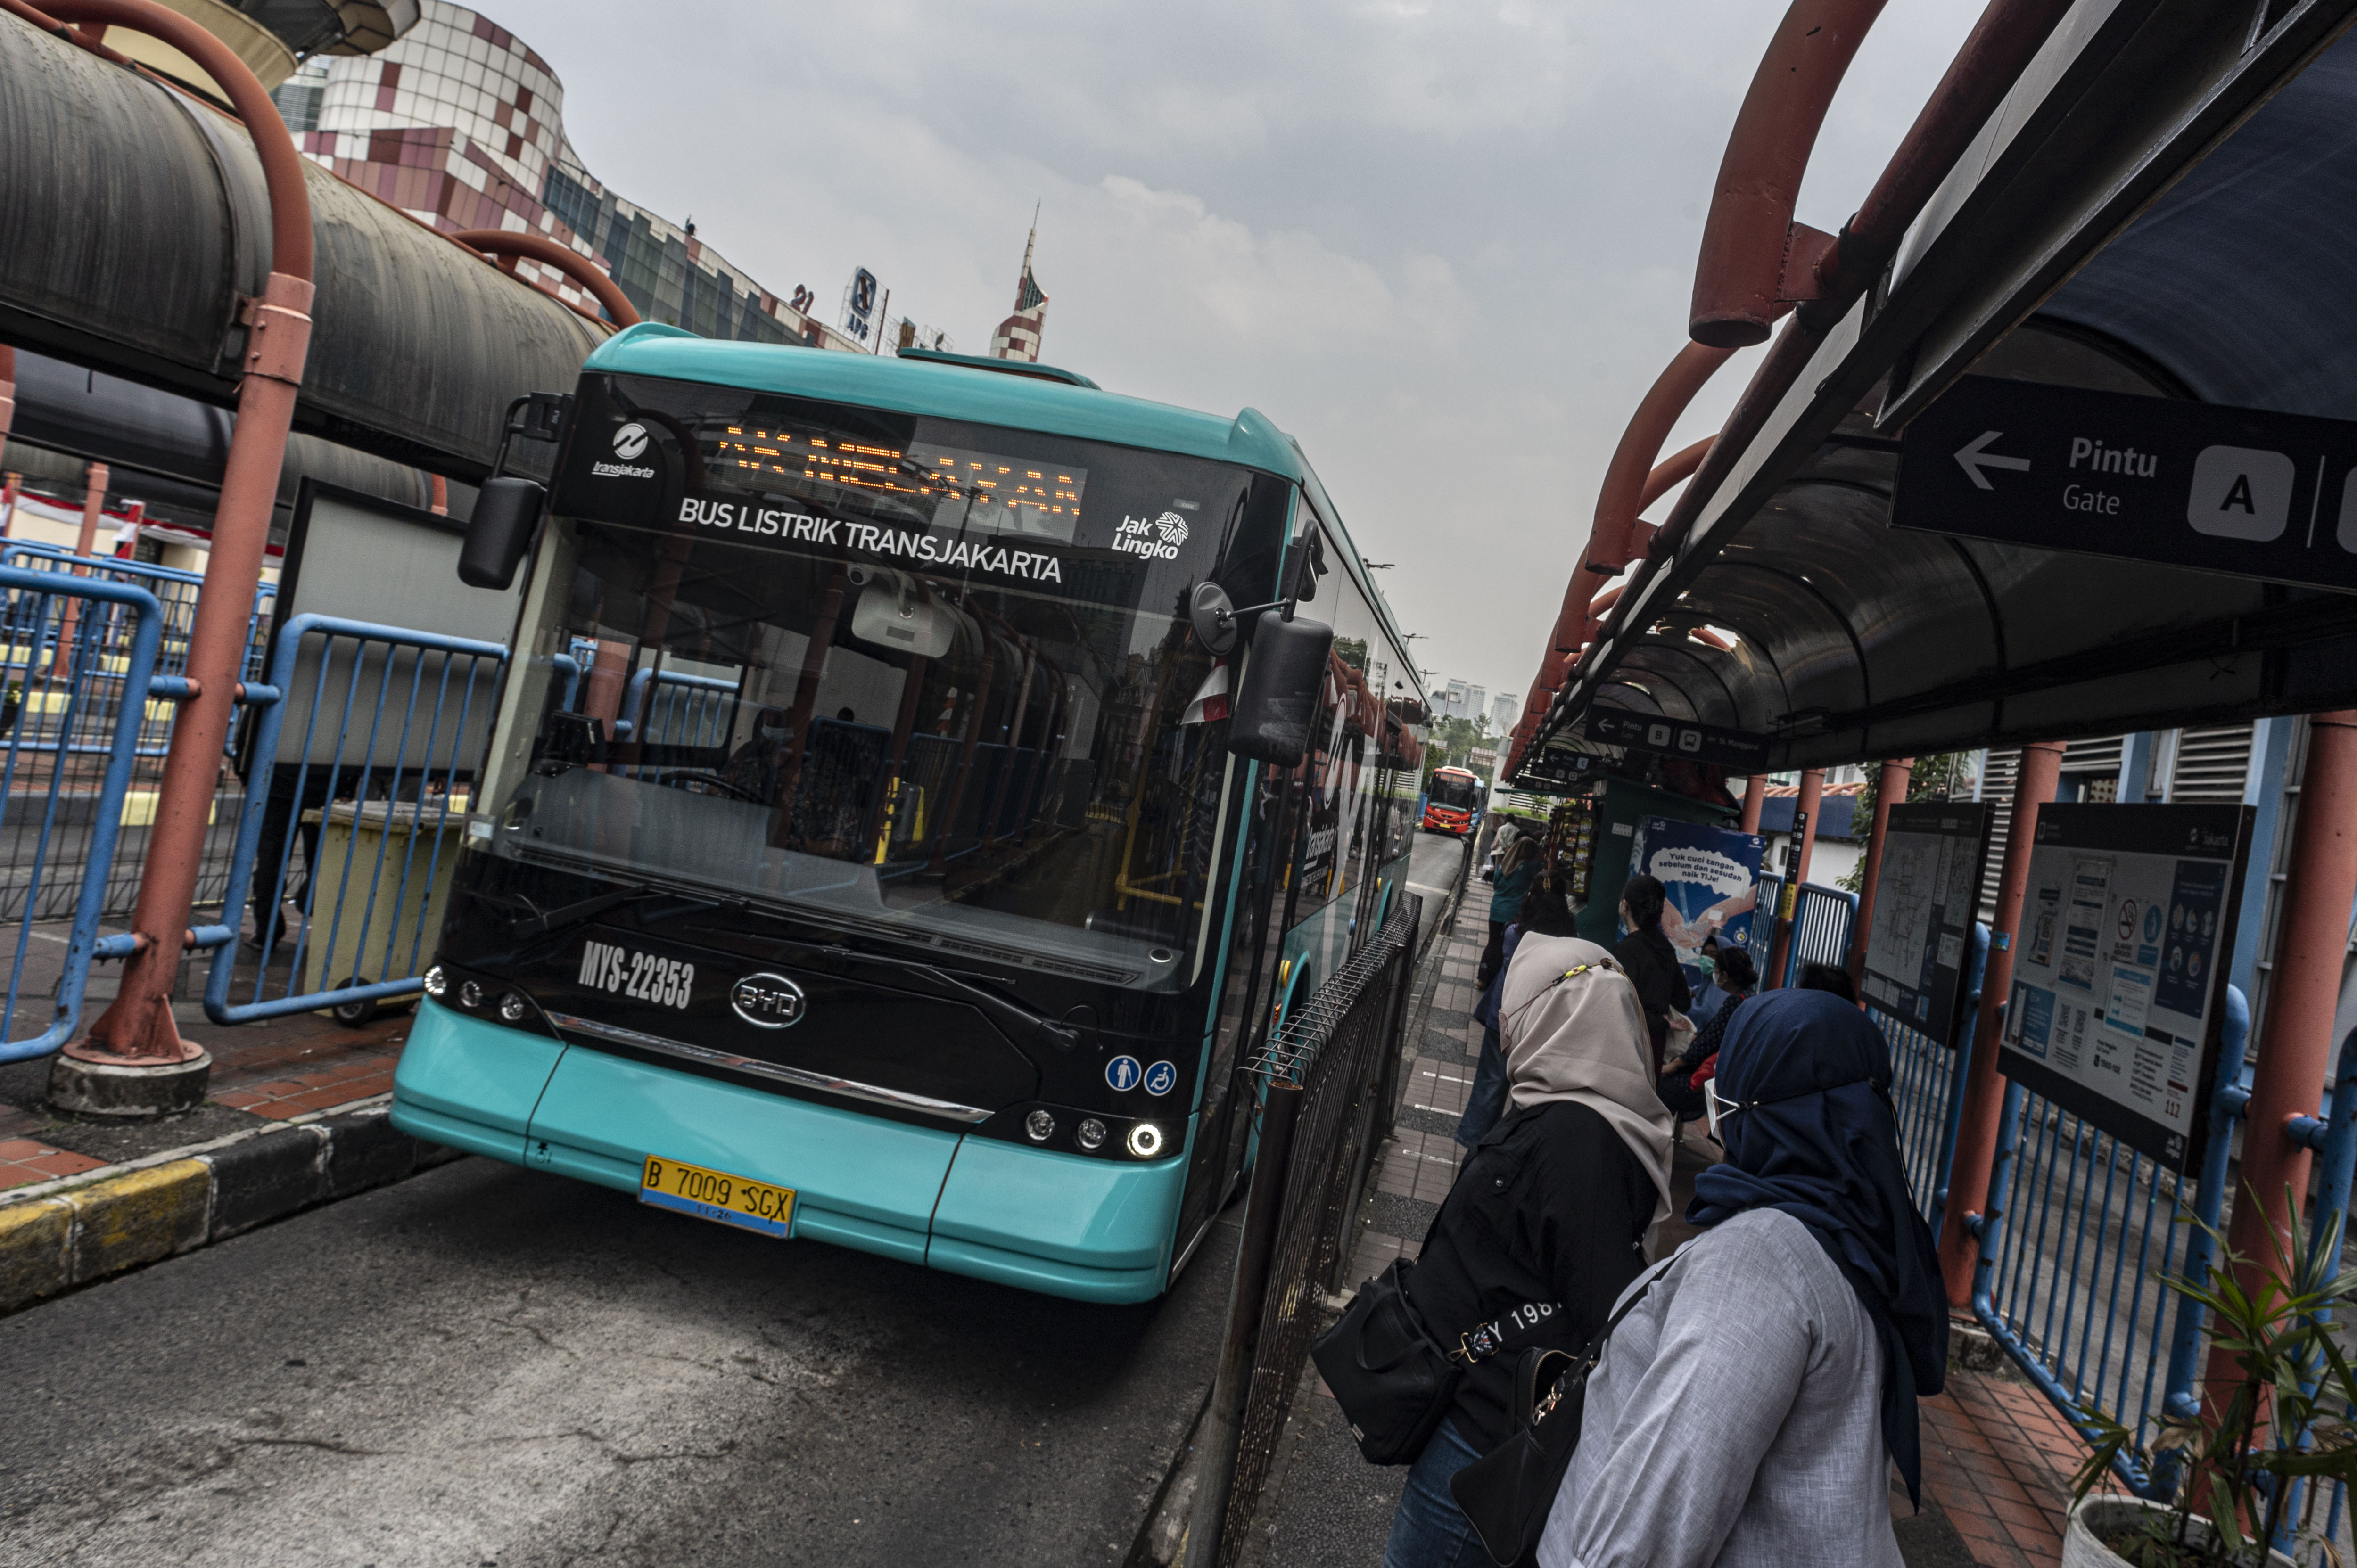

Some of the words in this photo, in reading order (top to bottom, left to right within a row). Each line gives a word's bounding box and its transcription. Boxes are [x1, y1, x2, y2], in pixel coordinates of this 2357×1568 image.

[2069, 436, 2158, 478] Pintu
[2063, 484, 2120, 515] Gate
[2219, 473, 2256, 516] A
[1115, 515, 1153, 536] Jak
[679, 498, 734, 527] BUS
[738, 507, 841, 545] LISTRIK
[845, 522, 1062, 583] TRANSJAKARTA
[1111, 533, 1178, 560] Lingko
[1622, 720, 1643, 731] Pintu
[1655, 731, 1663, 740] B
[1659, 861, 1692, 869] sebelum
[1710, 868, 1742, 882] sesudah
[1700, 873, 1719, 883] TiJe!
[1706, 858, 1735, 871] tangan
[578, 941, 694, 1009] MYS-22353
[739, 985, 797, 1017] BYD
[646, 1161, 662, 1187] B
[677, 1168, 732, 1205] 7009
[744, 1186, 789, 1221] SGX
